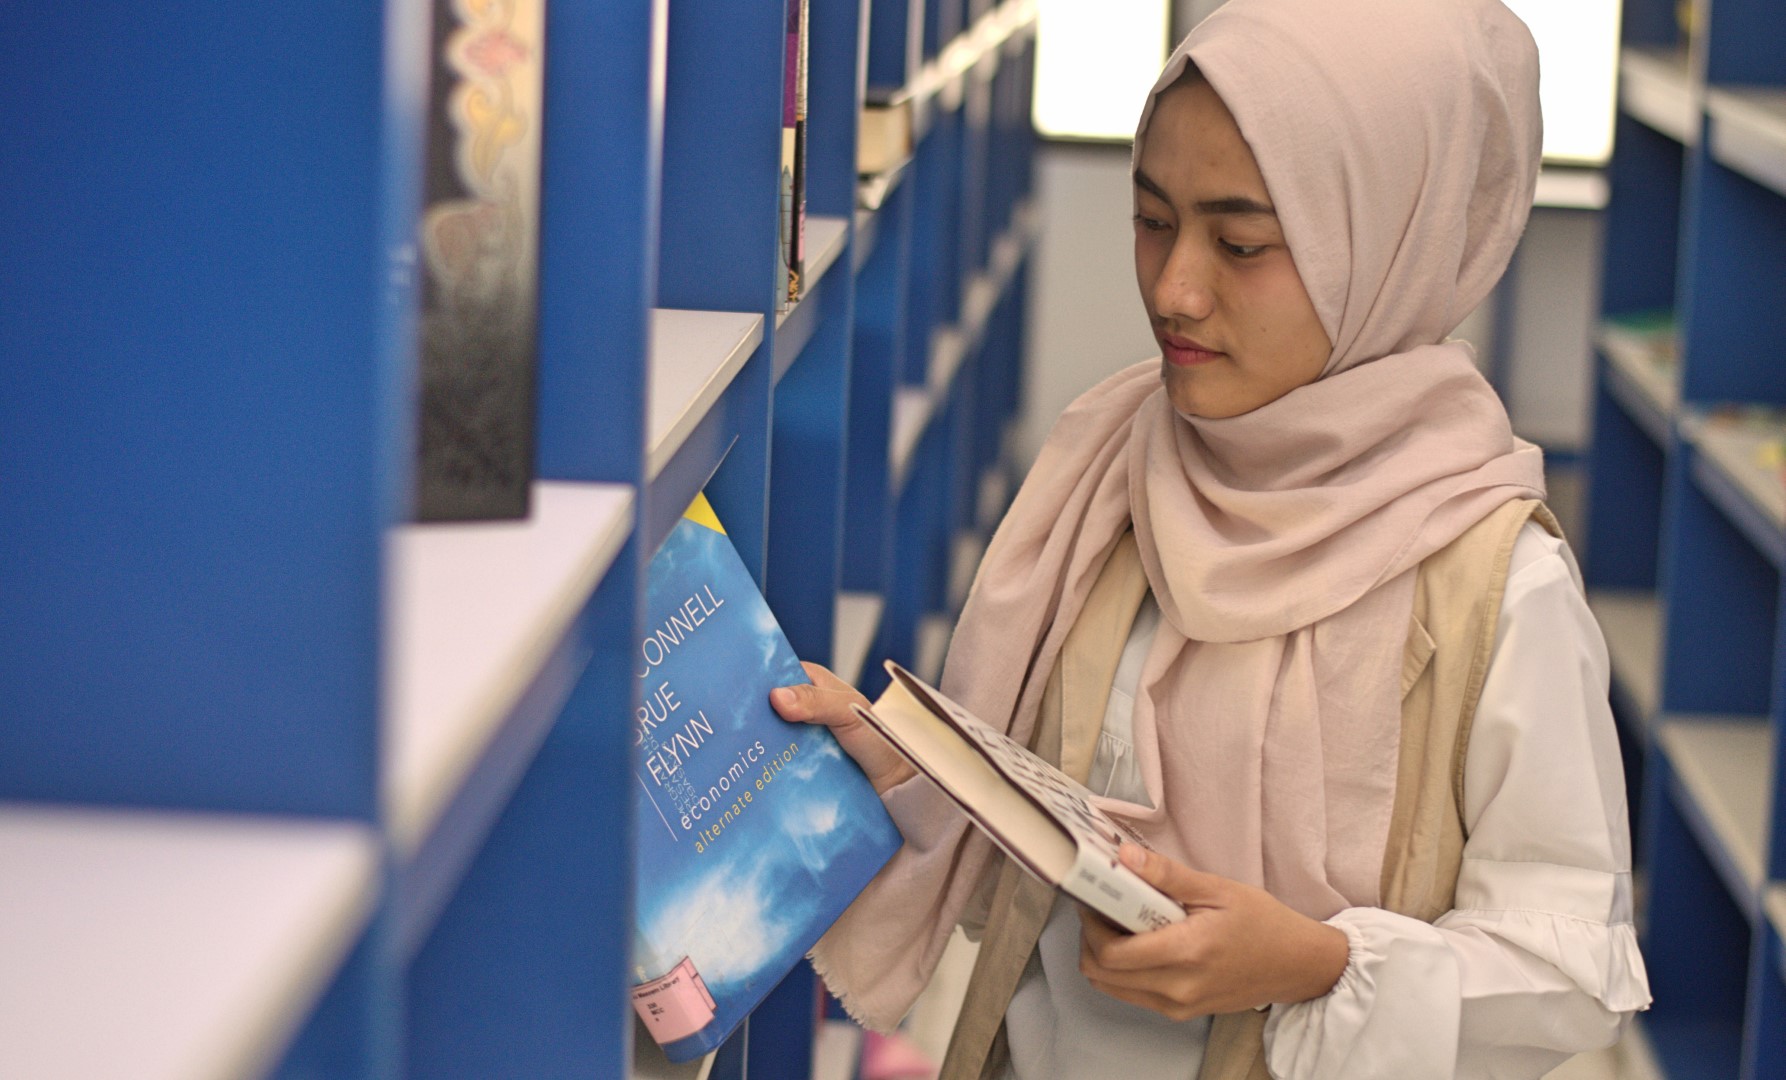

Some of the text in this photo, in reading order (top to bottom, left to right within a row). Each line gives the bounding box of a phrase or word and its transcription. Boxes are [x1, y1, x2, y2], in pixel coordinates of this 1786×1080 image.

[646, 710, 714, 786] FLYNN
[680, 739, 765, 830] economics
[695, 741, 800, 853] alternate edition
